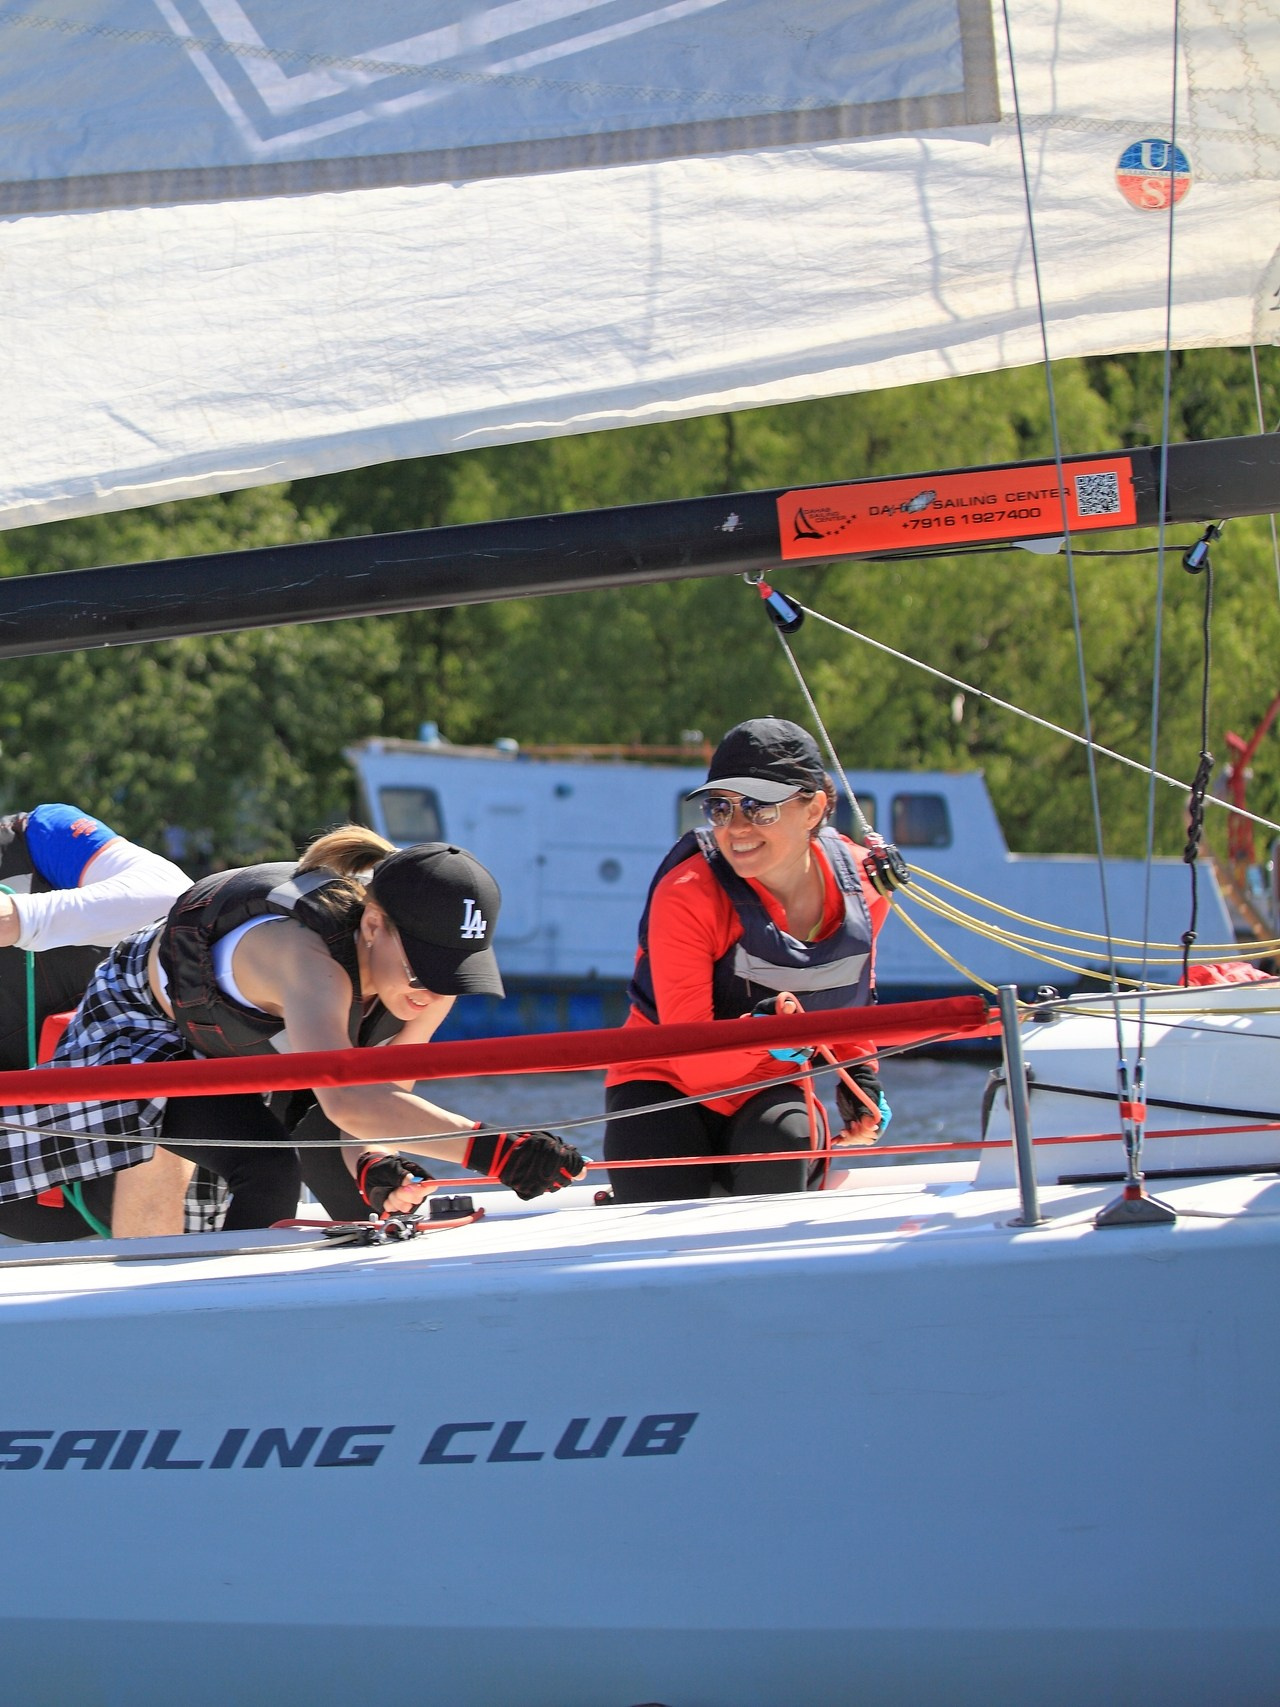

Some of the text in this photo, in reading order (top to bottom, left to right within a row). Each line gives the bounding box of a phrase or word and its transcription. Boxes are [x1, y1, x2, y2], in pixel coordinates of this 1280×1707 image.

[1141, 177, 1167, 208] S
[932, 494, 997, 510] SAILING
[1005, 488, 1071, 503] CENTER
[902, 507, 1041, 530] +7916 1927400
[460, 898, 488, 939] LA
[418, 1412, 700, 1465] CLUB
